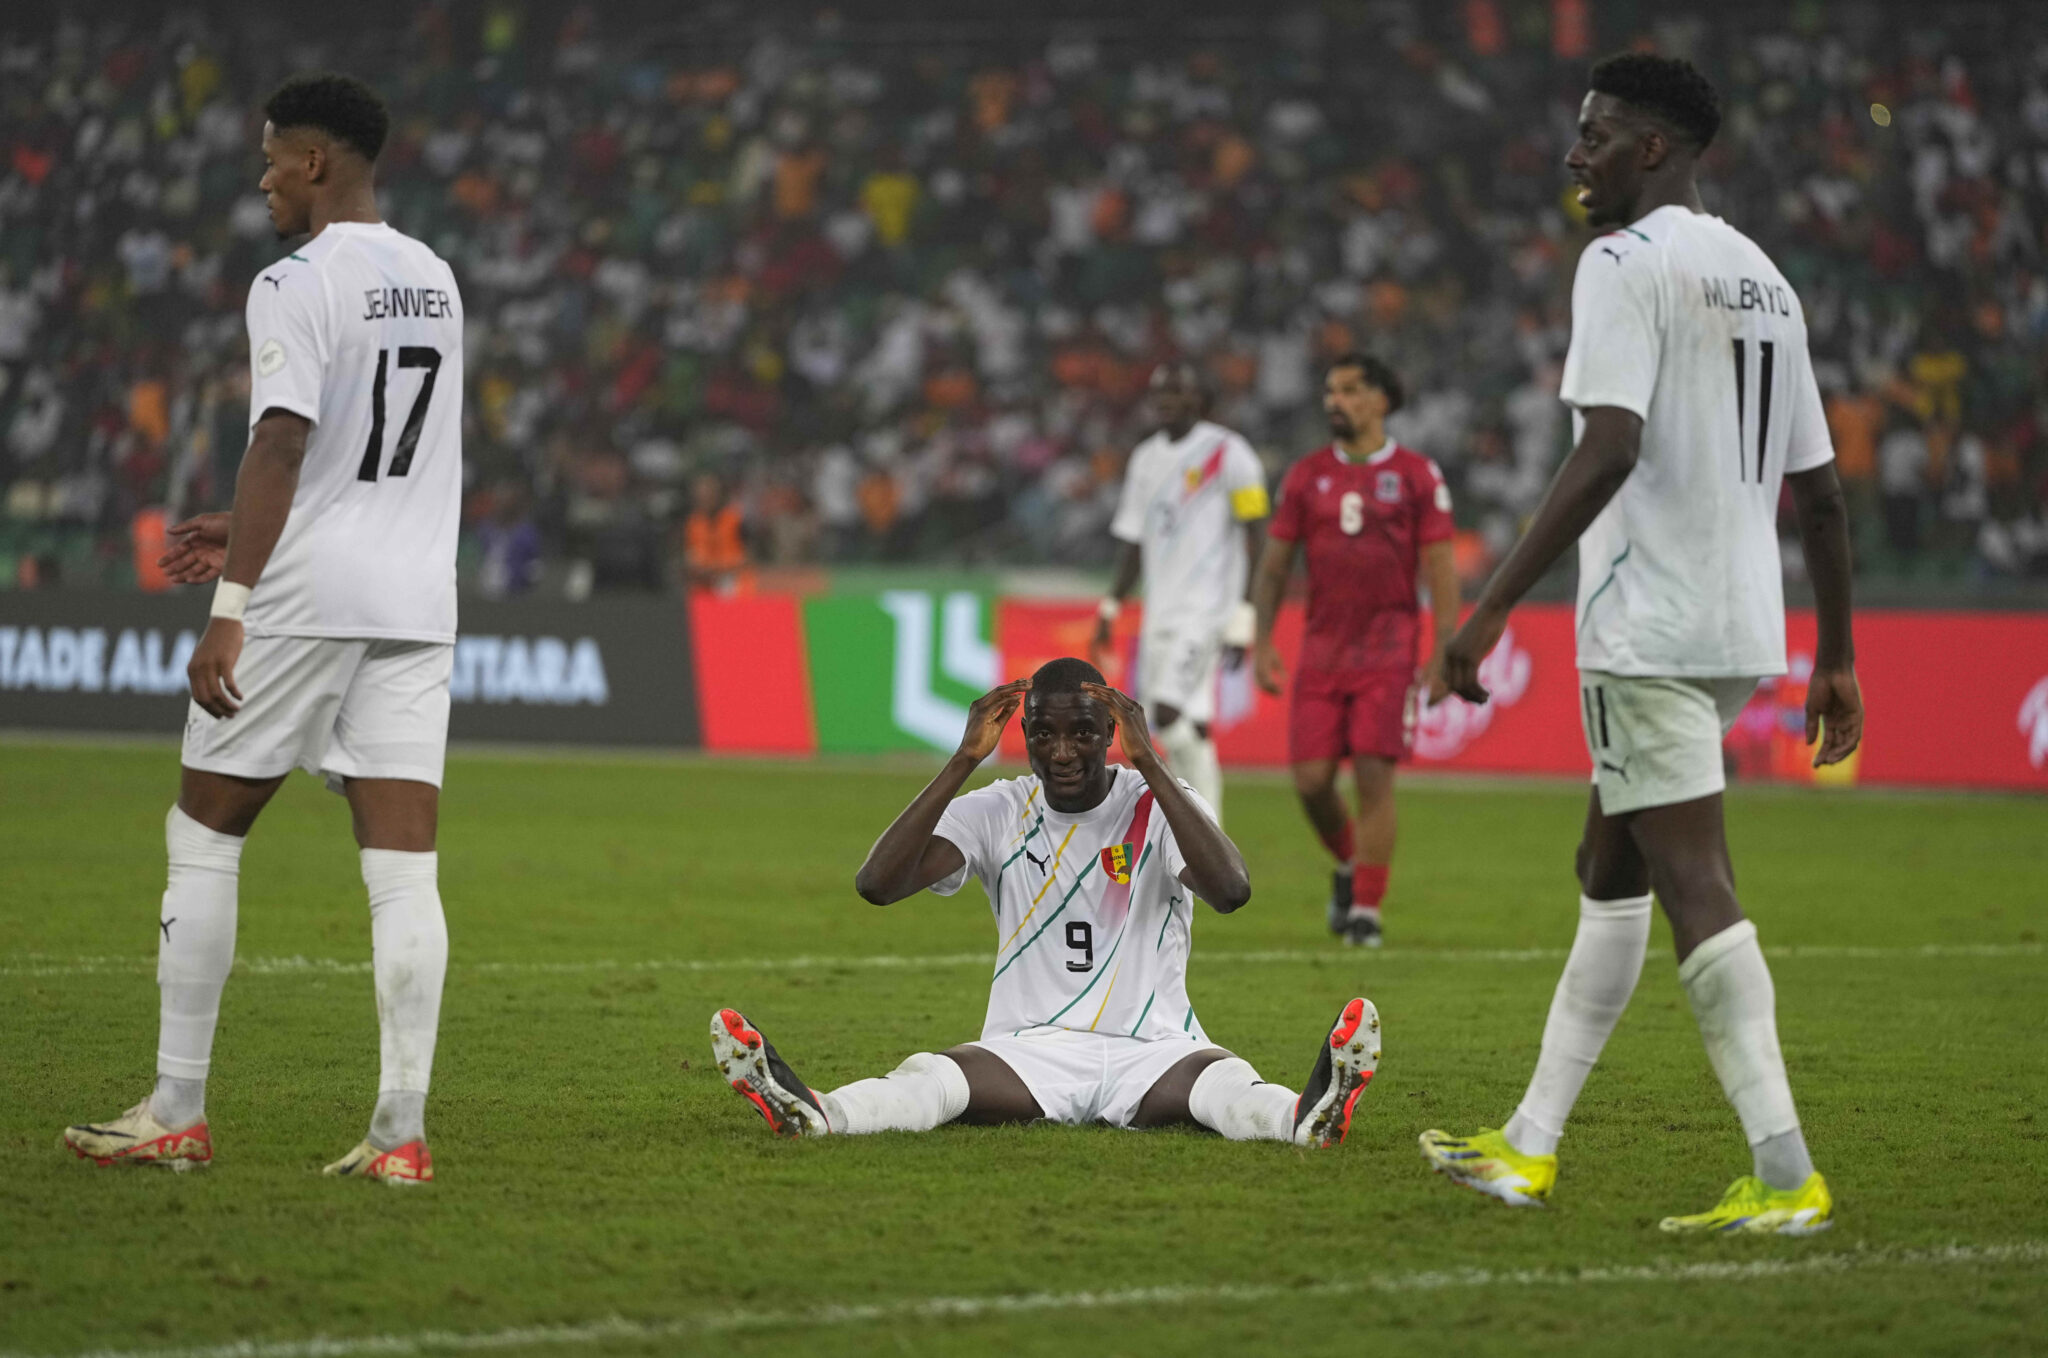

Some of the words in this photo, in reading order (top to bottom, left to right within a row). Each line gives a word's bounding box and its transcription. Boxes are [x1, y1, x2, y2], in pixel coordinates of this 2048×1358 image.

[363, 286, 453, 320] JEANVIER
[357, 346, 443, 482] 17
[1732, 338, 1774, 484] 11
[449, 634, 611, 705] TTARA
[1583, 685, 1610, 749] 11
[1065, 921, 1093, 972] 9
